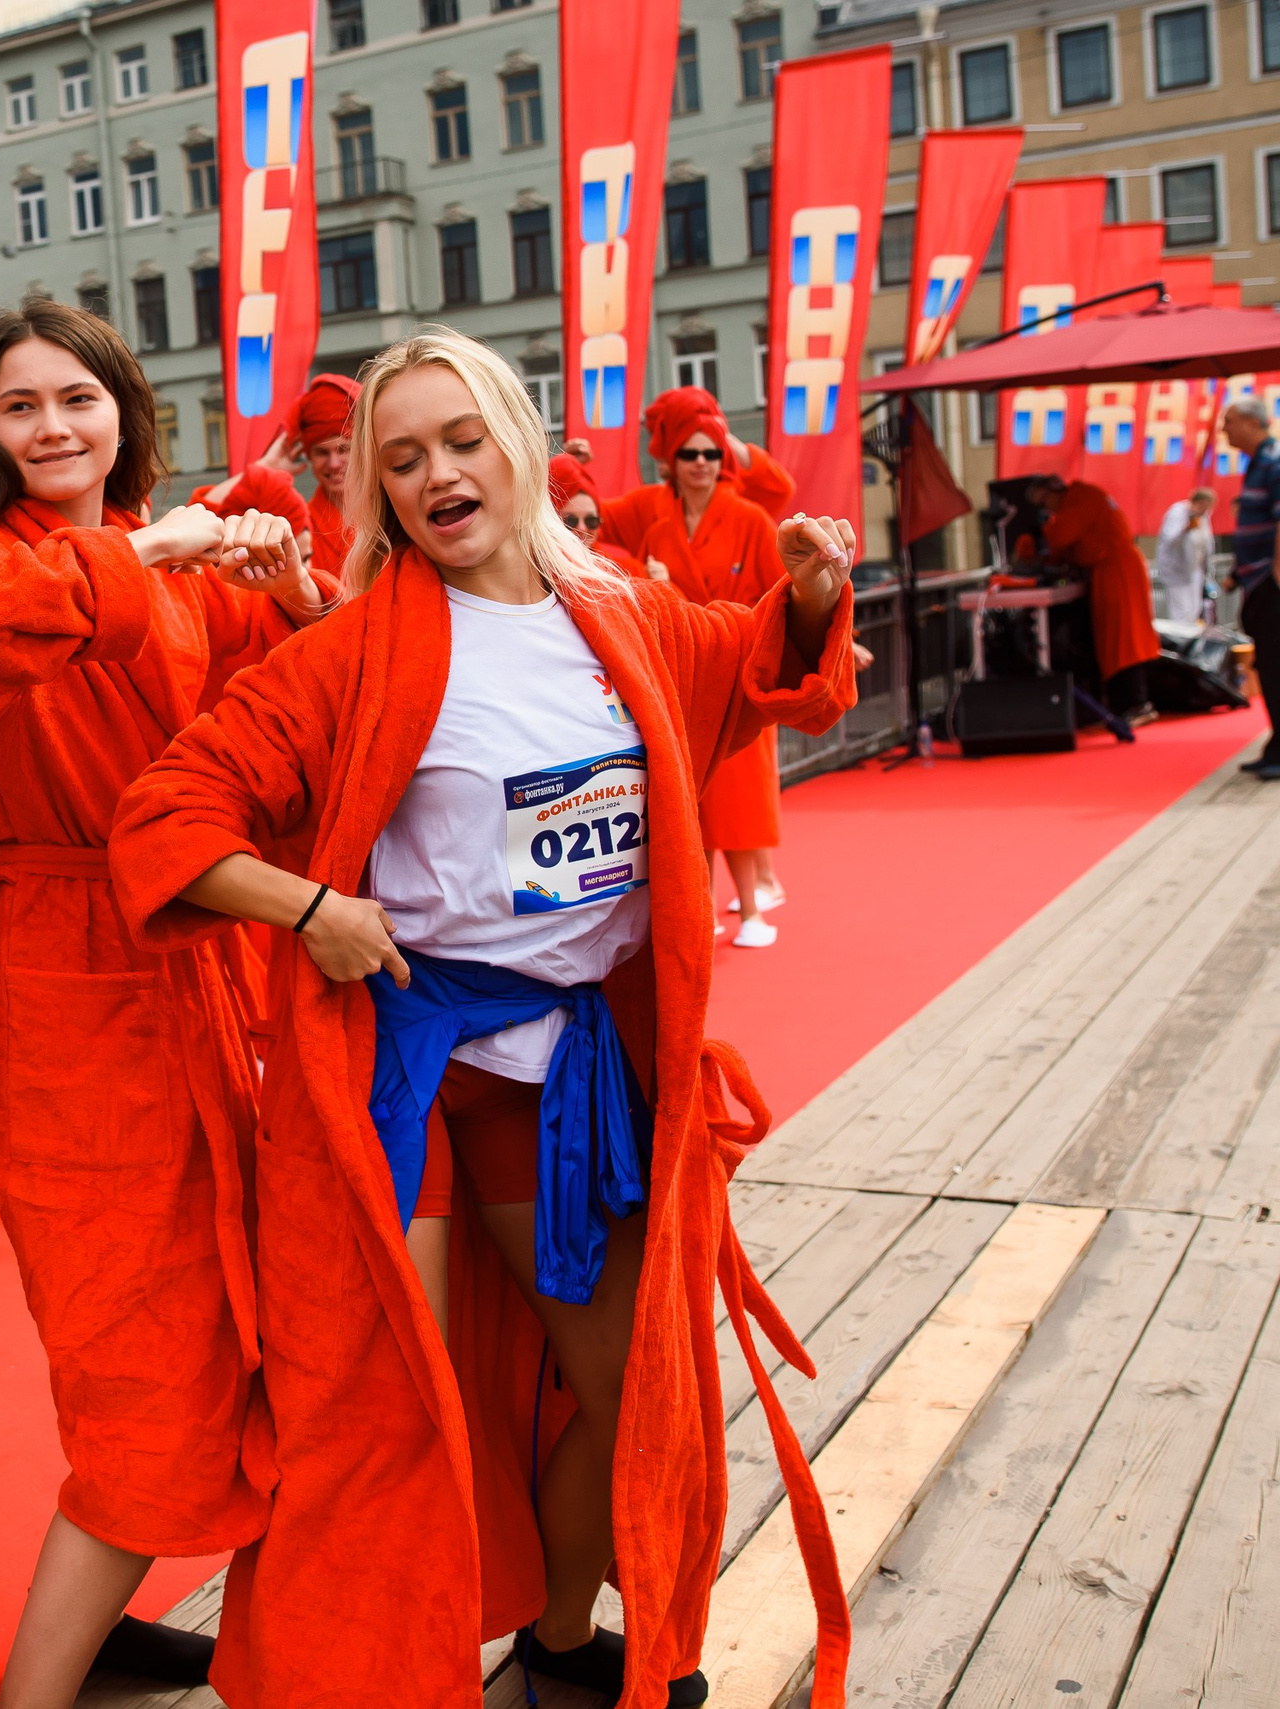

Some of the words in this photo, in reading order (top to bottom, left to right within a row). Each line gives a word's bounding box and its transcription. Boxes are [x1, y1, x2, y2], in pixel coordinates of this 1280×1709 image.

[782, 205, 860, 435] ТНТ
[524, 782, 564, 802] фонтанка.ру
[536, 785, 627, 822] ФОНТАНКА
[582, 805, 605, 815] августа
[606, 801, 621, 809] 2024
[584, 869, 629, 886] мегамаркет
